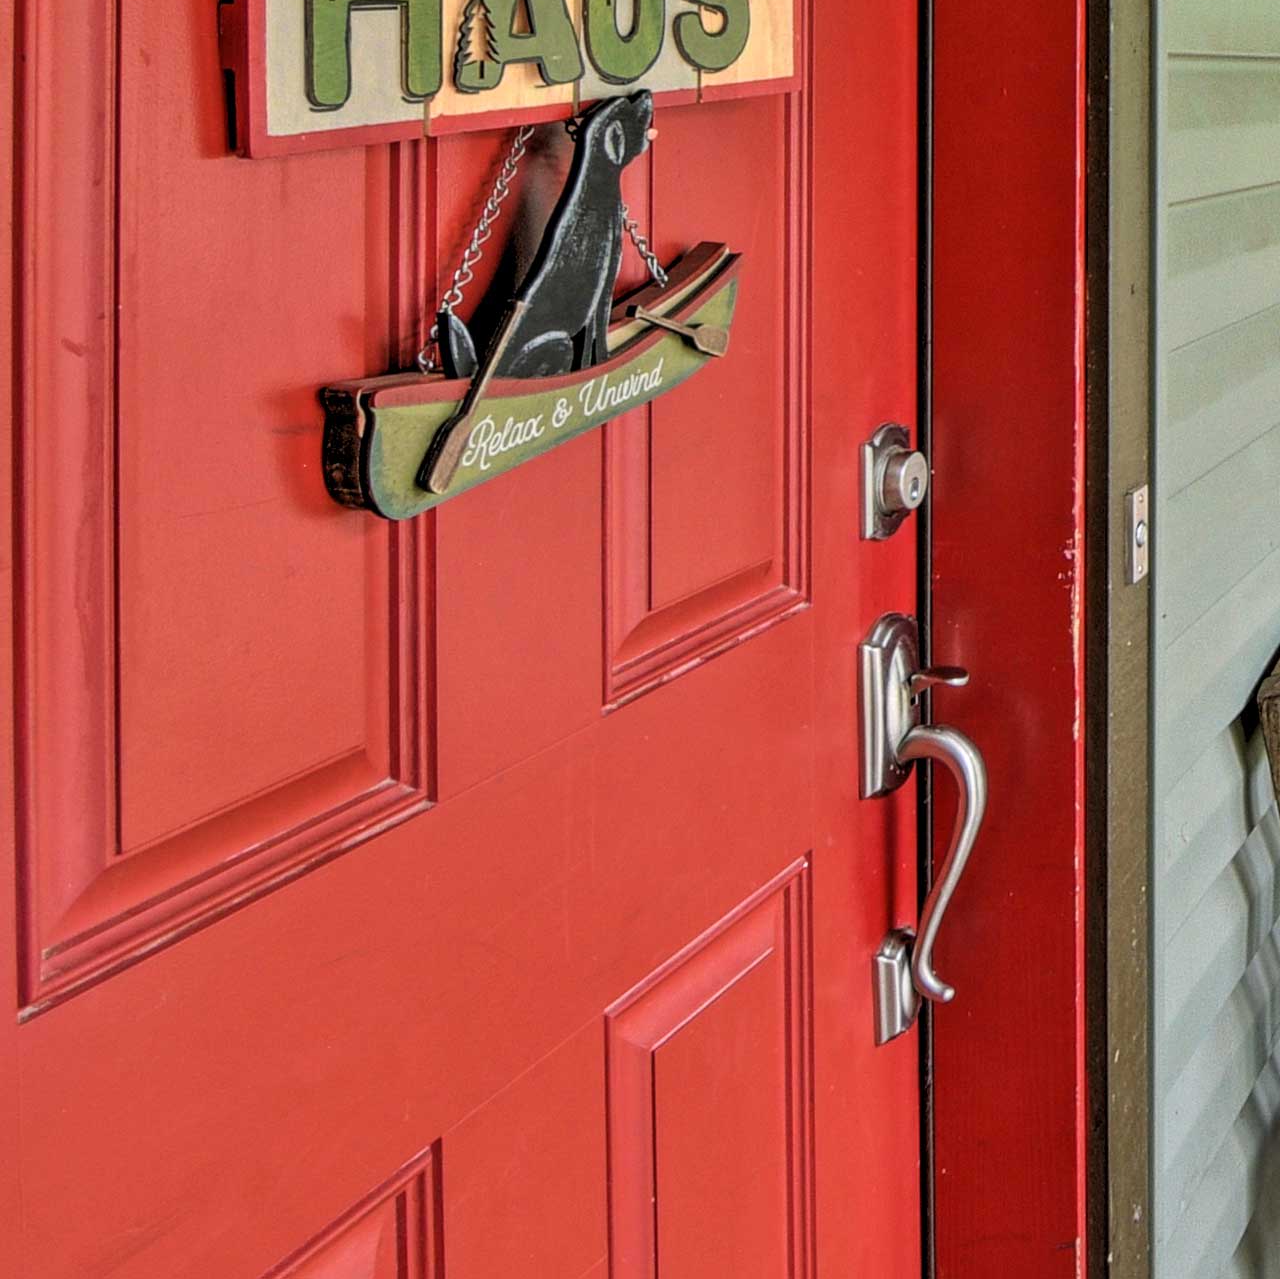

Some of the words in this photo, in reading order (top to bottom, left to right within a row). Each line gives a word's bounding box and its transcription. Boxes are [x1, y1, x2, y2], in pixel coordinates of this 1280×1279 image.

[462, 414, 545, 470] Relax
[551, 397, 573, 428] &
[578, 357, 665, 417] Unwind
